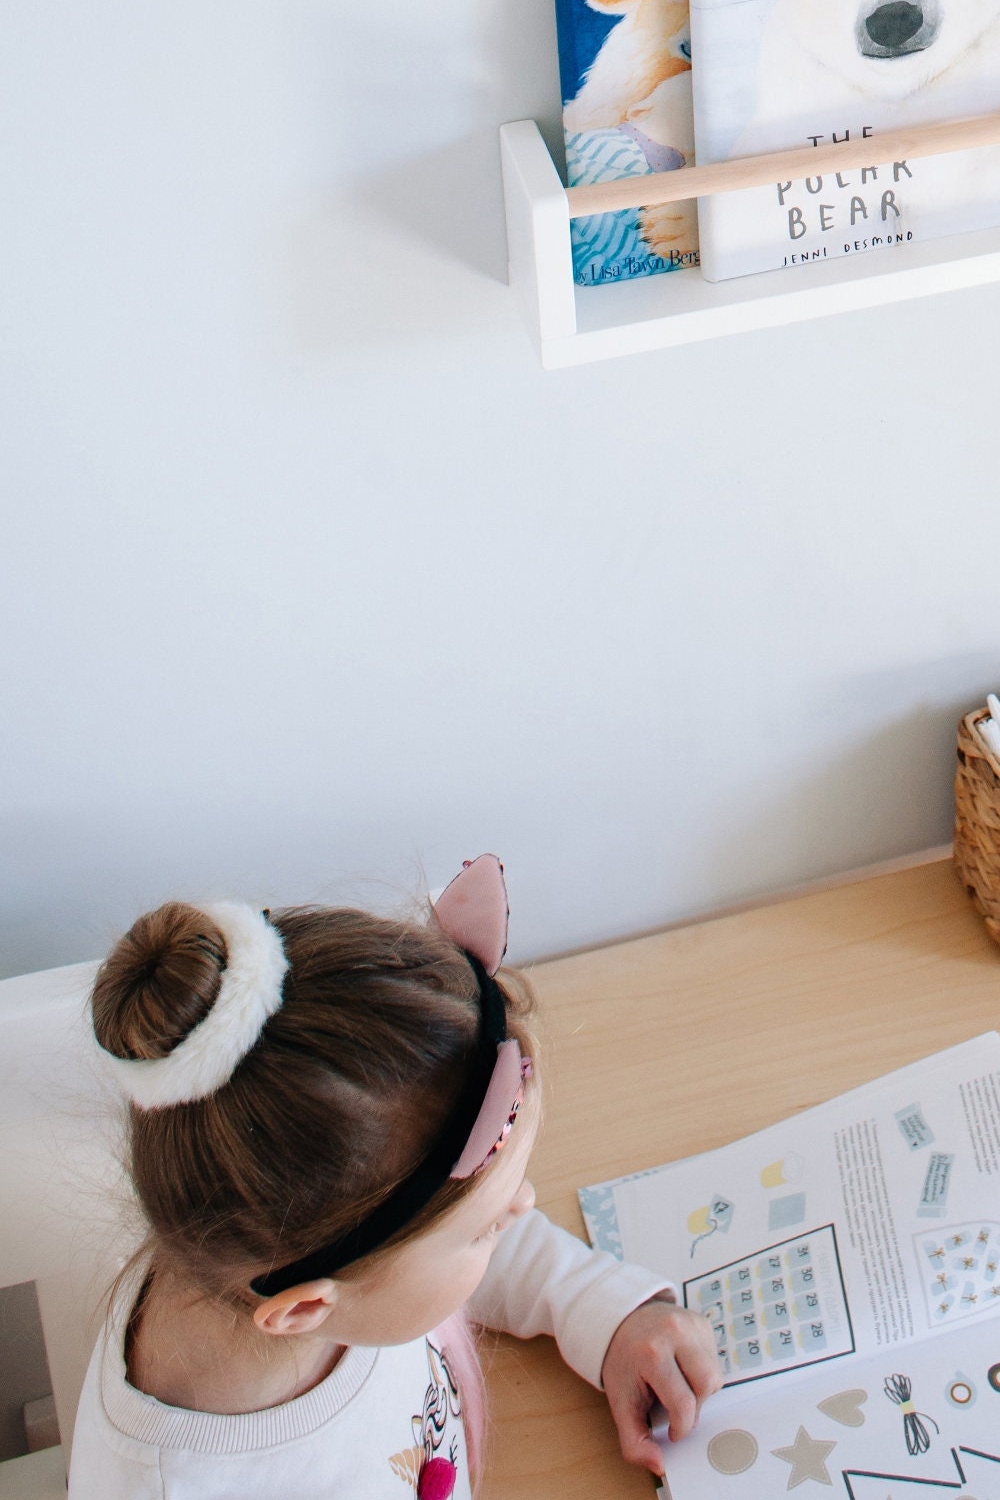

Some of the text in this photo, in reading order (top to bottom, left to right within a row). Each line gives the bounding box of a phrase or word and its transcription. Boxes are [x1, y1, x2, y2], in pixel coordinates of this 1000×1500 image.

[788, 189, 901, 240] BEAR
[783, 231, 914, 267] JENNI DESMOND
[591, 263, 621, 281] Lisa
[624, 256, 665, 275] Tawn
[738, 1268, 750, 1281] 23
[802, 1267, 813, 1282] 30
[741, 1290, 753, 1303] 22
[768, 1255, 792, 1345] 27 26 25 24
[805, 1293, 818, 1307] 29
[810, 1322, 824, 1338] 28
[747, 1340, 760, 1355] 20
